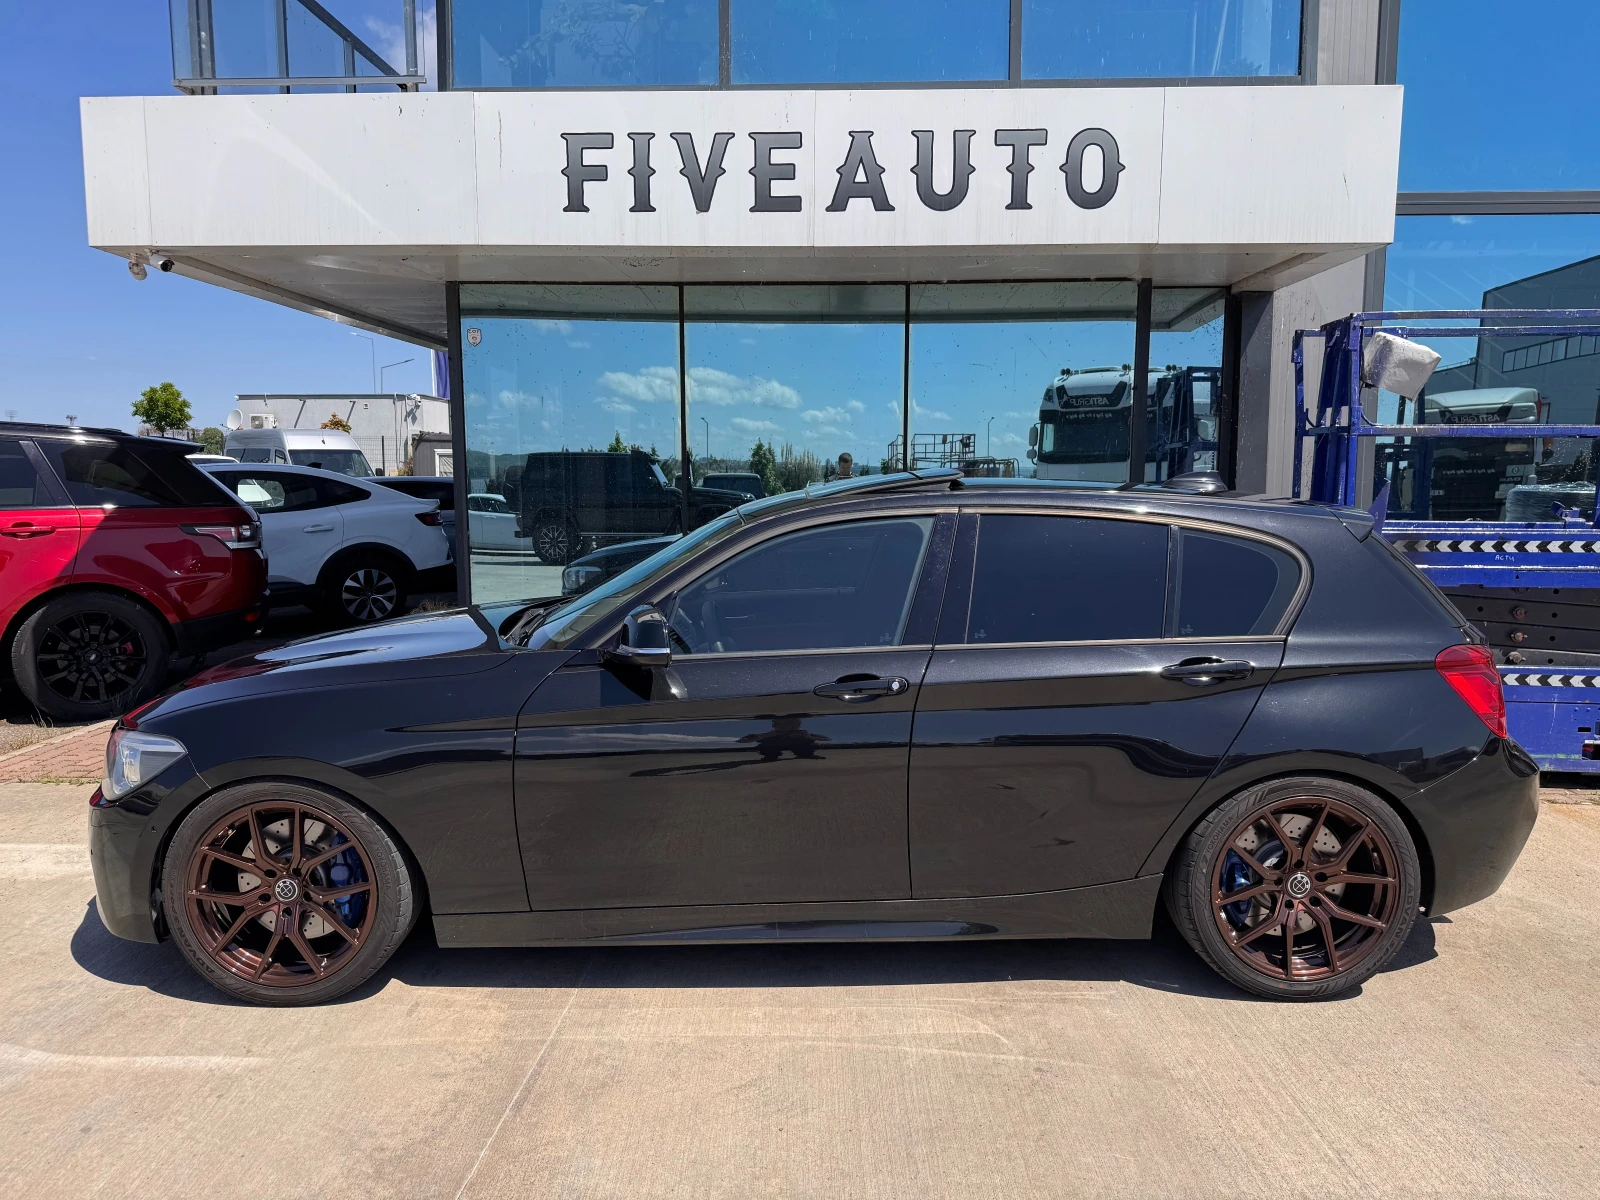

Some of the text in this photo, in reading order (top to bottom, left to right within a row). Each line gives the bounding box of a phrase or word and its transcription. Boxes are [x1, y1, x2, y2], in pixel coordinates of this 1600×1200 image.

[1205, 816, 1234, 853] YOKOHAMA
[375, 845, 392, 890] YOKOHAMA
[1395, 883, 1414, 939] ADVAN
